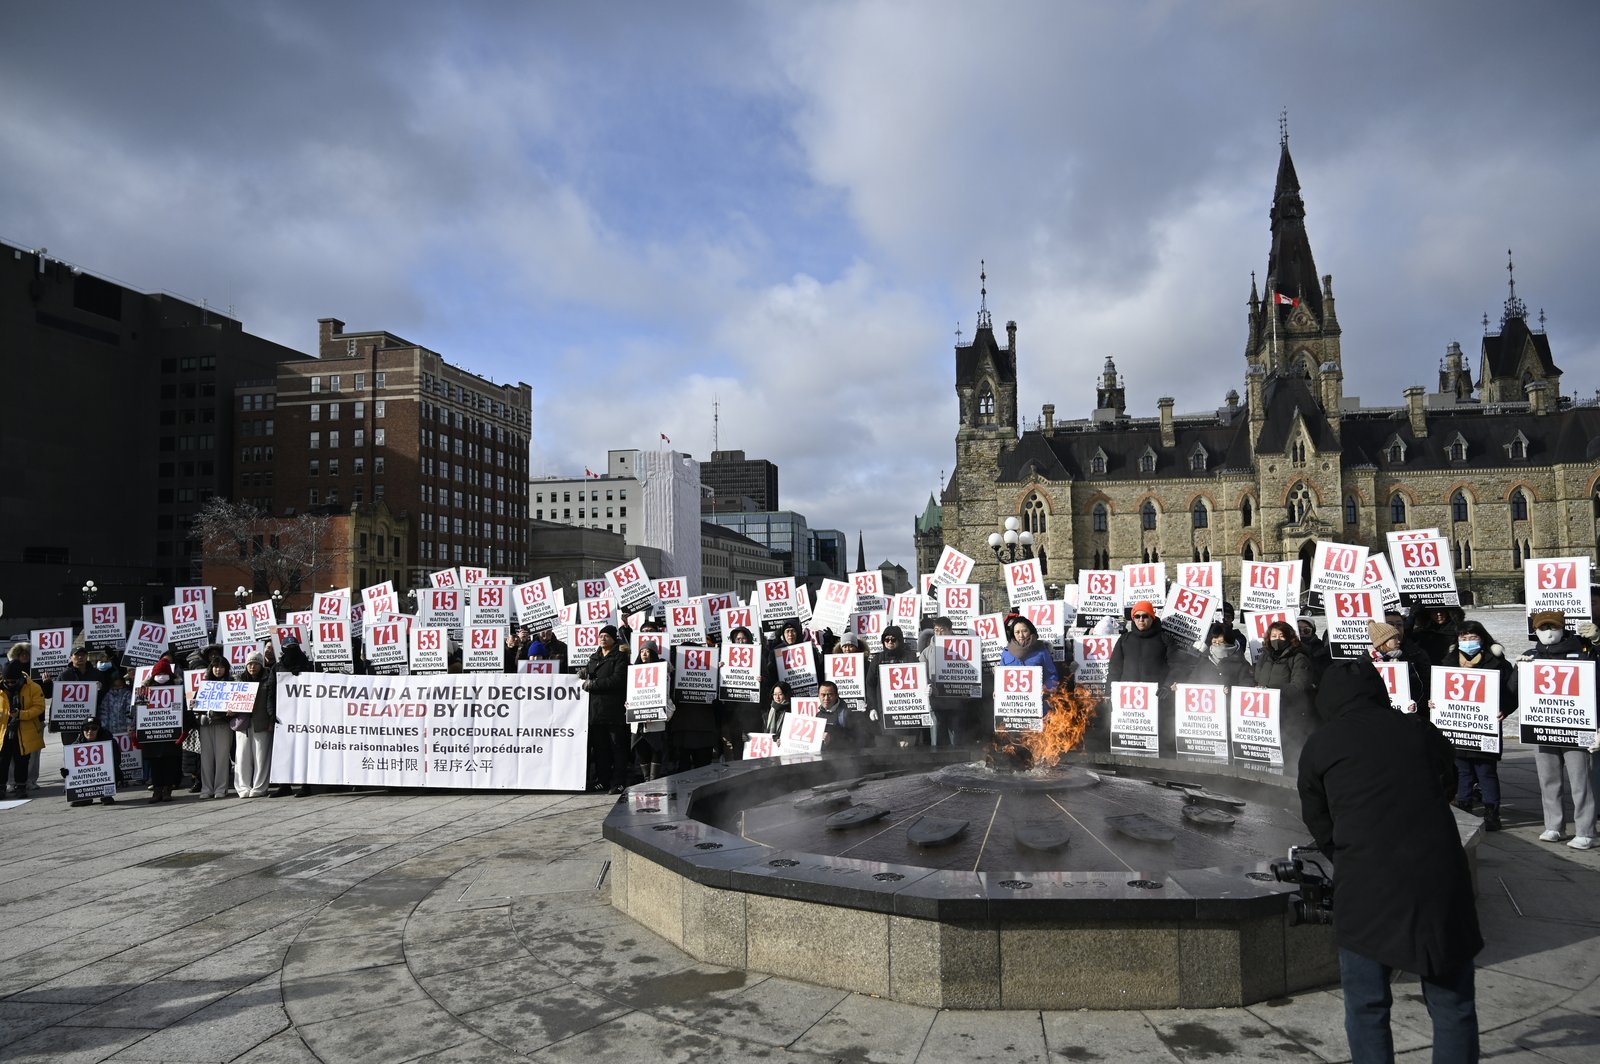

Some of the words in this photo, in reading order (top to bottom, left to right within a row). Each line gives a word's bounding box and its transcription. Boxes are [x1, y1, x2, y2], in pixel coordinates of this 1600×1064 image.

[1328, 549, 1354, 572] 70
[1406, 543, 1436, 567] 36
[945, 553, 965, 578] 43
[1013, 564, 1033, 585] 29
[467, 570, 482, 583] 31
[616, 565, 639, 586] 33
[857, 575, 875, 594] 38
[1090, 574, 1113, 593] 63
[1133, 567, 1154, 586] 11
[1188, 566, 1210, 587] 27
[1254, 566, 1275, 589] 16
[1542, 563, 1571, 589] 37
[481, 589, 500, 605] 53
[523, 583, 545, 605] 68
[587, 582, 604, 597] 39
[661, 581, 679, 598] 34
[767, 582, 787, 600] 33
[827, 581, 847, 603] 34
[948, 588, 969, 608] 65
[321, 598, 339, 614] 42
[435, 593, 455, 610] 15
[590, 601, 609, 620] 55
[900, 597, 914, 617] 55
[1178, 589, 1204, 618] 35
[1340, 593, 1369, 617] 31
[95, 608, 115, 623] 54
[175, 605, 195, 623] 42
[228, 614, 245, 630] 32
[676, 608, 695, 625] 34
[730, 609, 750, 627] 27
[1030, 605, 1052, 624] 72
[141, 625, 164, 642] 20
[324, 624, 341, 641] 11
[860, 616, 880, 633] 30
[976, 618, 996, 638] 62
[42, 633, 61, 648] 30
[378, 626, 397, 644] 71
[420, 631, 438, 649] 53
[474, 630, 494, 648] 34
[578, 628, 597, 646] 68
[731, 648, 752, 667] 33
[784, 647, 804, 669] 46
[947, 639, 970, 661] 40
[1086, 640, 1110, 660] 23
[688, 650, 708, 670] 81
[835, 657, 854, 676] 24
[205, 682, 227, 691] STOP
[231, 683, 249, 691] THE
[637, 667, 656, 688] 41
[892, 667, 916, 690] 34
[1007, 670, 1030, 692] 35
[1539, 666, 1574, 694] 37
[65, 685, 86, 701] 20
[286, 684, 312, 698] WE
[316, 685, 395, 700] DEMAND
[400, 687, 411, 700] A
[417, 686, 483, 700] TIMELY
[488, 686, 581, 700] DECISION
[1449, 673, 1481, 701] 37
[1123, 687, 1145, 709] 18
[1188, 689, 1214, 712] 36
[1244, 692, 1267, 717] 21
[1539, 698, 1575, 706] MONTHS
[348, 703, 428, 717] DELAYED
[434, 703, 459, 717] BY
[464, 704, 509, 718] IRCC
[1440, 711, 1471, 720] WAITING
[1448, 704, 1480, 712] MONTHS
[288, 724, 357, 734] REASONABLE
[359, 727, 418, 736] TIMELINES
[791, 718, 815, 742] 22
[1453, 721, 1493, 730] RESPONSE
[1545, 717, 1590, 725] RESPONSE
[433, 728, 513, 737] PROCEDURAL
[517, 728, 574, 737] FAIRNESS
[1247, 735, 1276, 743] RESPONSE
[1452, 732, 1482, 740] TIMELINE
[315, 741, 346, 750] Délais
[350, 742, 419, 752] raisonnables
[433, 742, 470, 754] Équité
[473, 744, 543, 754] procédurale
[752, 736, 771, 757] 43
[77, 747, 100, 766] 36
[362, 757, 418, 771] 给出时限
[434, 759, 493, 772] 程序公平
